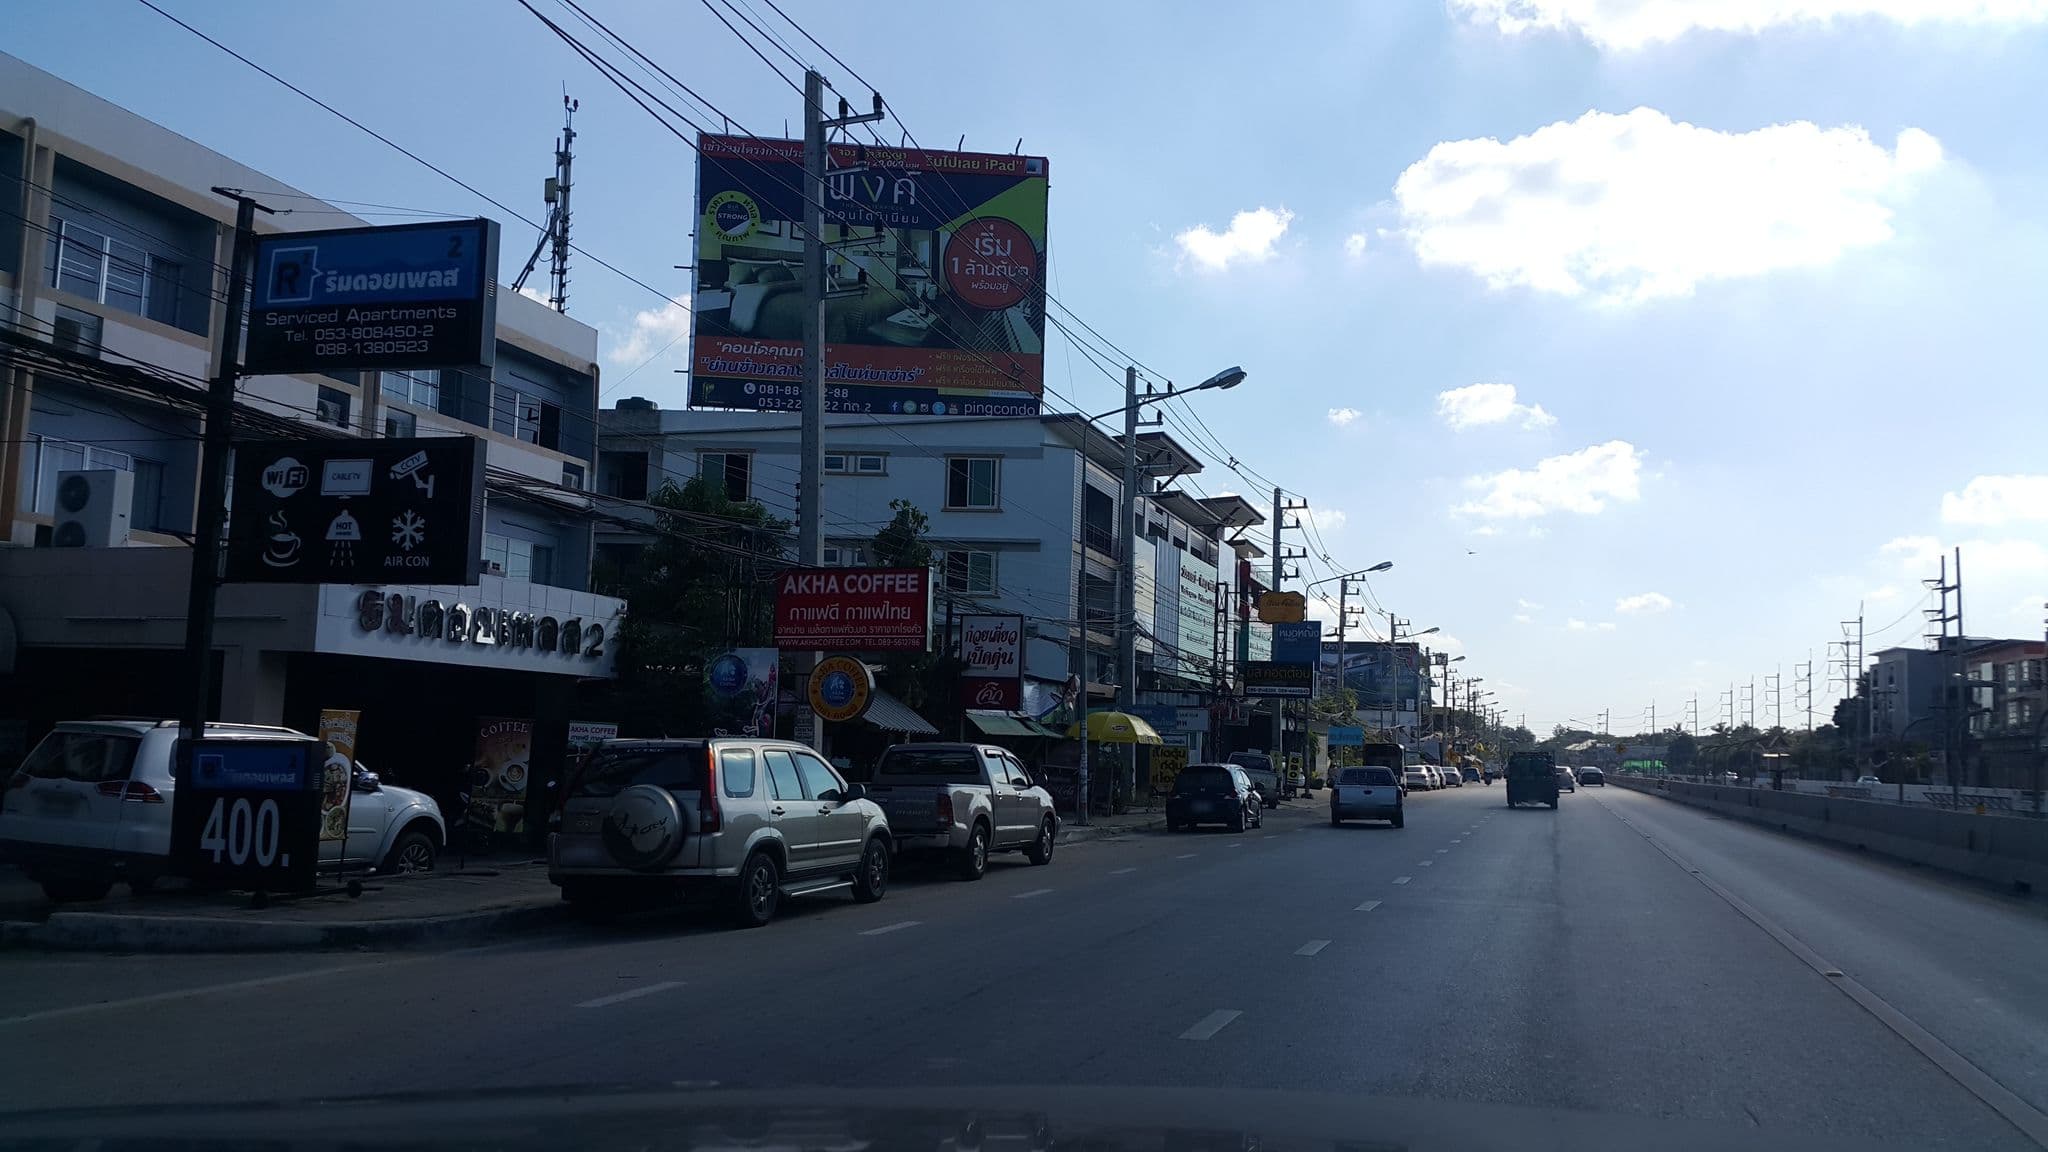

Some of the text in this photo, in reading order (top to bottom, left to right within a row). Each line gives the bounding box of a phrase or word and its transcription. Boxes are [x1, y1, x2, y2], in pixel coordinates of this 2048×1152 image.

[717, 212, 748, 221] STRONG
[974, 223, 1012, 257] เริ่ม
[325, 266, 460, 294] ริมดอยเพลส
[265, 306, 457, 327] Serviced Apartments
[314, 325, 435, 342] 053-808450-2
[315, 340, 430, 356] 088-1380523
[964, 401, 1036, 417] pingcondo
[400, 455, 422, 471] CCTV
[336, 522, 353, 530] HOT
[384, 555, 431, 567] AIR CON
[783, 573, 919, 595] AKHA COFFEE
[789, 600, 911, 621] กาแฟดี กาแฟไทย
[480, 720, 529, 738] COFFEE
[591, 727, 617, 736] COFFEE
